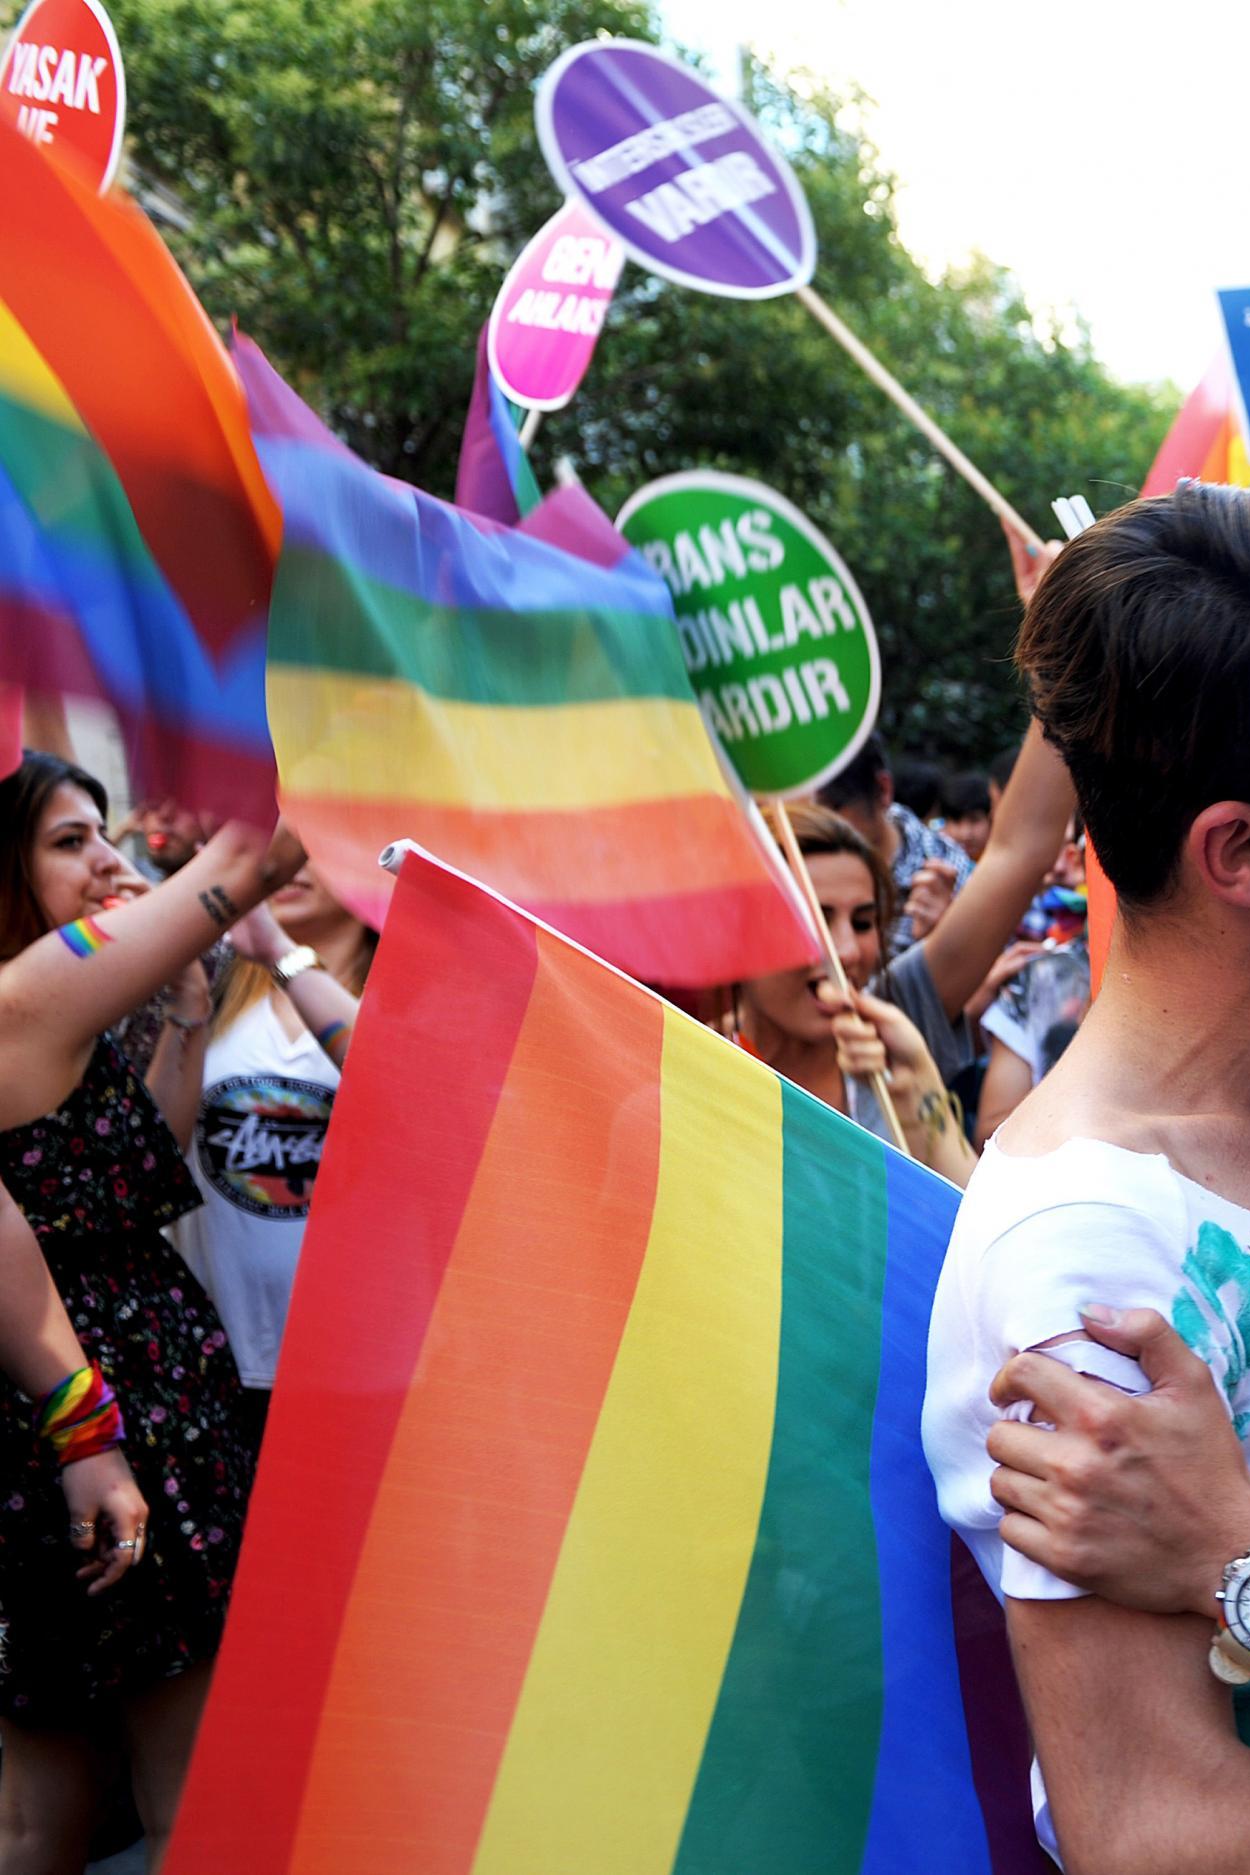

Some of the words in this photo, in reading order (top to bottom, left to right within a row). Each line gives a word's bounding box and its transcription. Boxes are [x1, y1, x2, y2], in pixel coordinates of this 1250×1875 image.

[8, 41, 108, 115] YASAK
[643, 510, 785, 597] RANS
[678, 576, 856, 673] DINLAR
[700, 657, 850, 742] ARDIR
